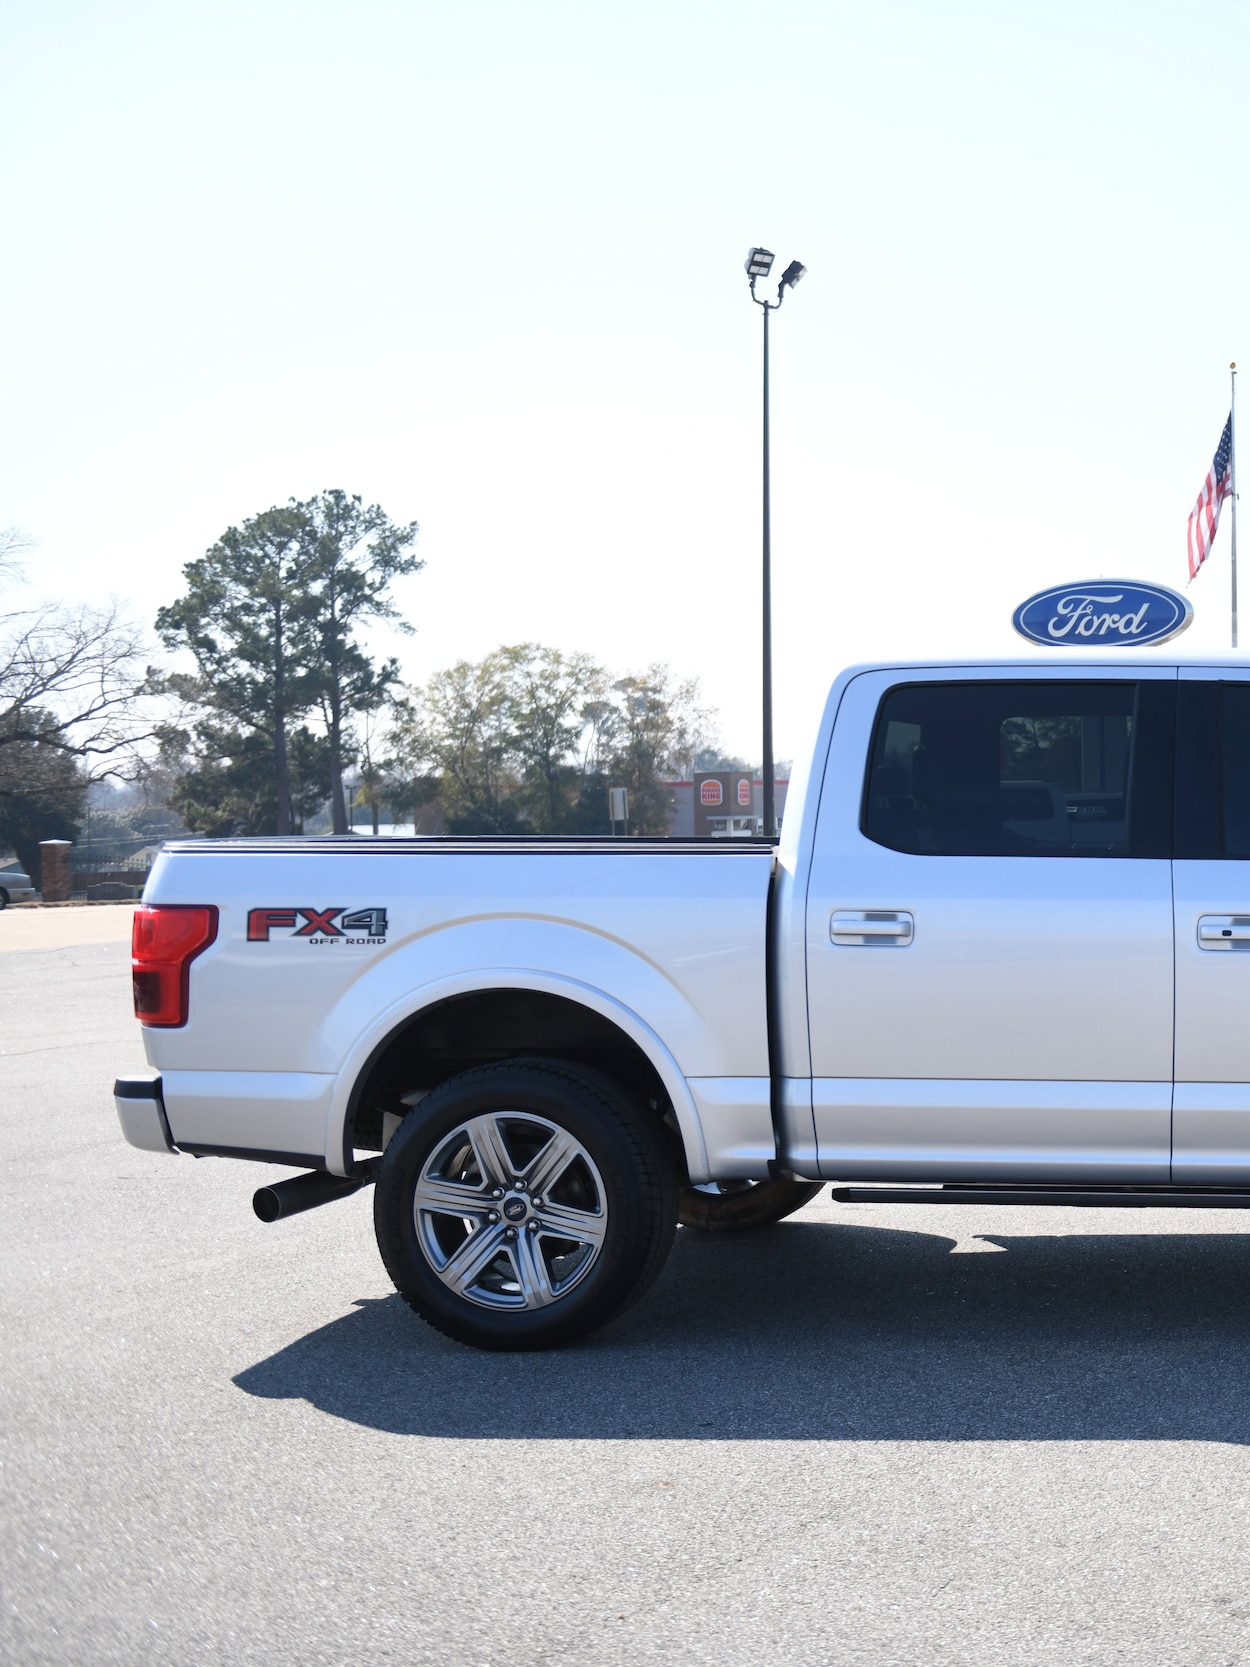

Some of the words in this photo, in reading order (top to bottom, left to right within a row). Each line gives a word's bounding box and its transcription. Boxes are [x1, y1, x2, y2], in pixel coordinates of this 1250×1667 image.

[1048, 594, 1151, 637] Ford
[701, 792, 721, 800] KING
[246, 907, 388, 942] FX4
